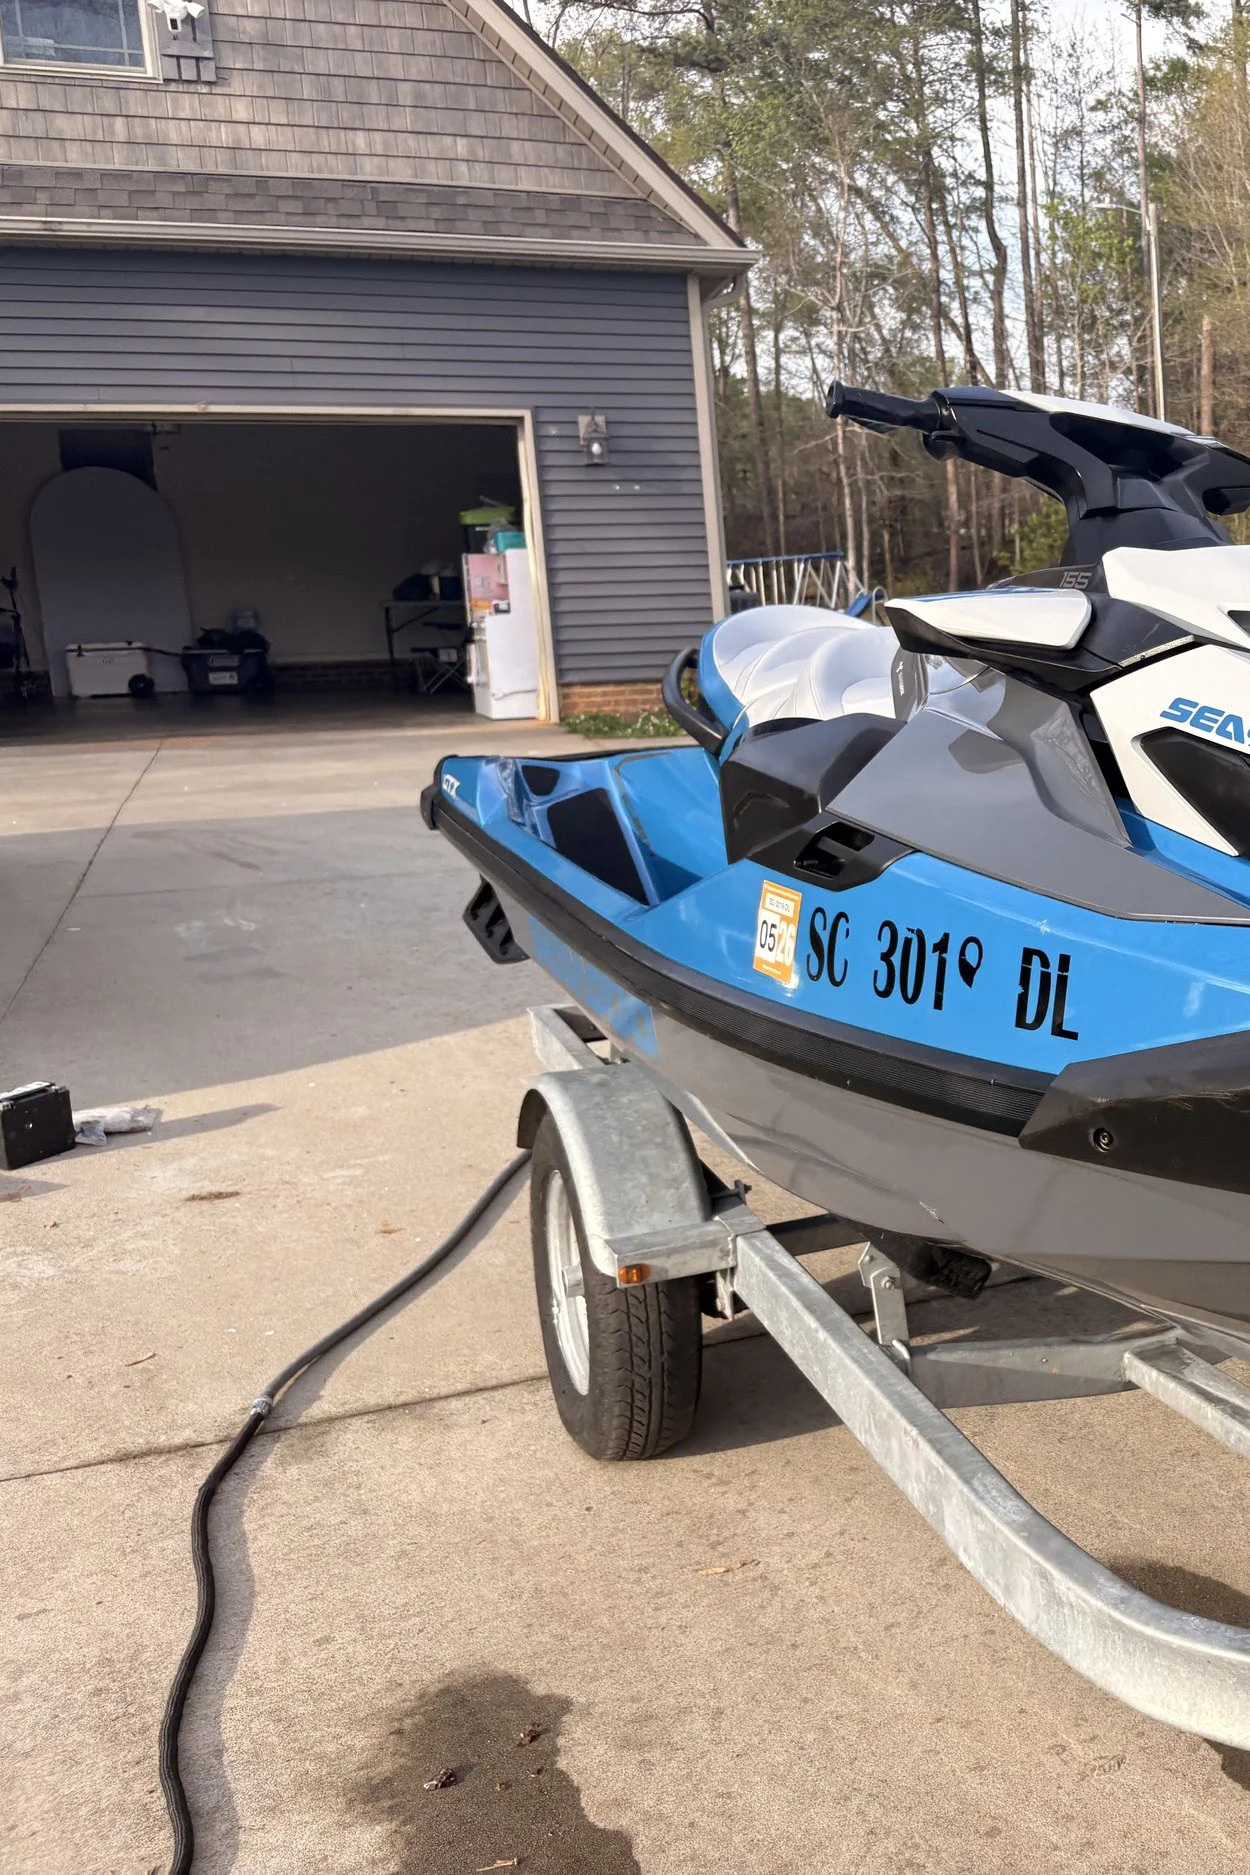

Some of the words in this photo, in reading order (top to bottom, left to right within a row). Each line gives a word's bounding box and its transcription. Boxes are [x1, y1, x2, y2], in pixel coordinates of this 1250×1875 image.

[1059, 571, 1092, 589] 155
[759, 919, 777, 952] 05
[806, 906, 850, 988] SC
[1015, 946, 1079, 1041] DL
